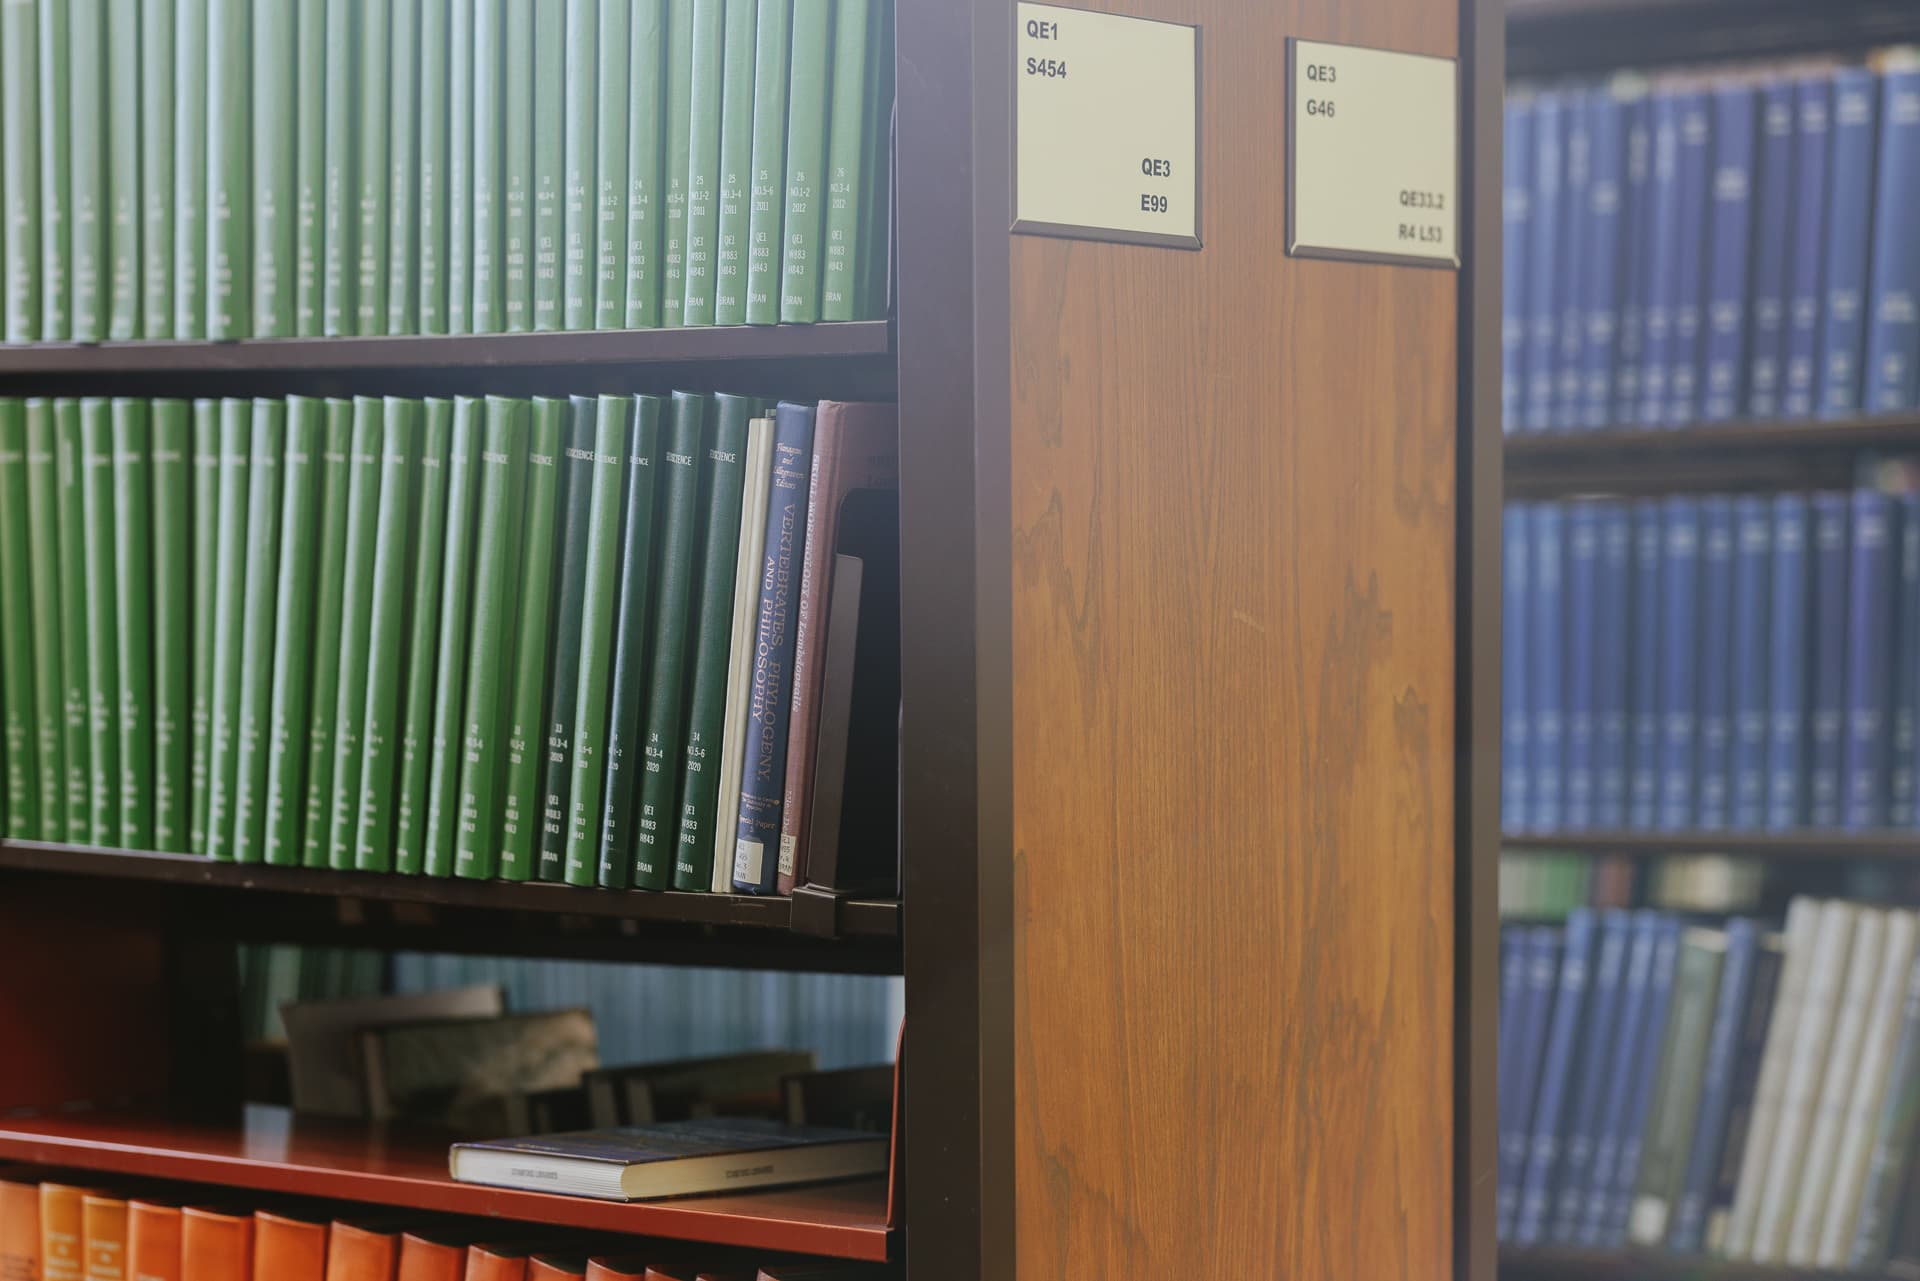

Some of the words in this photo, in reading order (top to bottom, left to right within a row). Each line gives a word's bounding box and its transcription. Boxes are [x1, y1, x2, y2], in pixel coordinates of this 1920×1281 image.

[1027, 20, 1058, 40] QE1
[1027, 57, 1067, 79] S454
[1307, 64, 1337, 83] QE3
[1306, 99, 1335, 118] G46
[836, 167, 845, 177] 26
[1141, 158, 1171, 177] QE3
[696, 175, 704, 185] 25
[728, 174, 736, 184] 25
[760, 170, 768, 180] 25
[796, 171, 805, 182] 26
[724, 204, 737, 215] 2011
[756, 201, 769, 211] 2011
[792, 203, 806, 213] 2012
[1141, 194, 1168, 213] E99
[692, 206, 705, 216] 2011
[755, 231, 767, 242] QE1
[832, 230, 842, 241] QE1
[1399, 223, 1416, 241] R4
[693, 236, 704, 247] QE1
[724, 235, 735, 246] QE1
[792, 234, 803, 244] QE1
[801, 502, 816, 598] MORPHOLOGY
[764, 555, 776, 591] AND
[770, 503, 796, 650] VERTEBRATES,
[800, 600, 809, 619] OF
[752, 599, 773, 723] PHILOSOPHY
[757, 661, 781, 781] PHYLOGENY,
[651, 732, 659, 742] 34
[693, 732, 700, 742] 34
[645, 746, 663, 759] NO.3-4
[687, 745, 706, 758] NO.5-6
[646, 761, 660, 773] 2020
[687, 760, 701, 772] 2020
[643, 804, 654, 816] QE1
[684, 803, 695, 816] QE1
[640, 819, 657, 831] W883
[681, 818, 697, 830] W883
[636, 861, 653, 873] BRAN
[677, 861, 693, 874] BRAN
